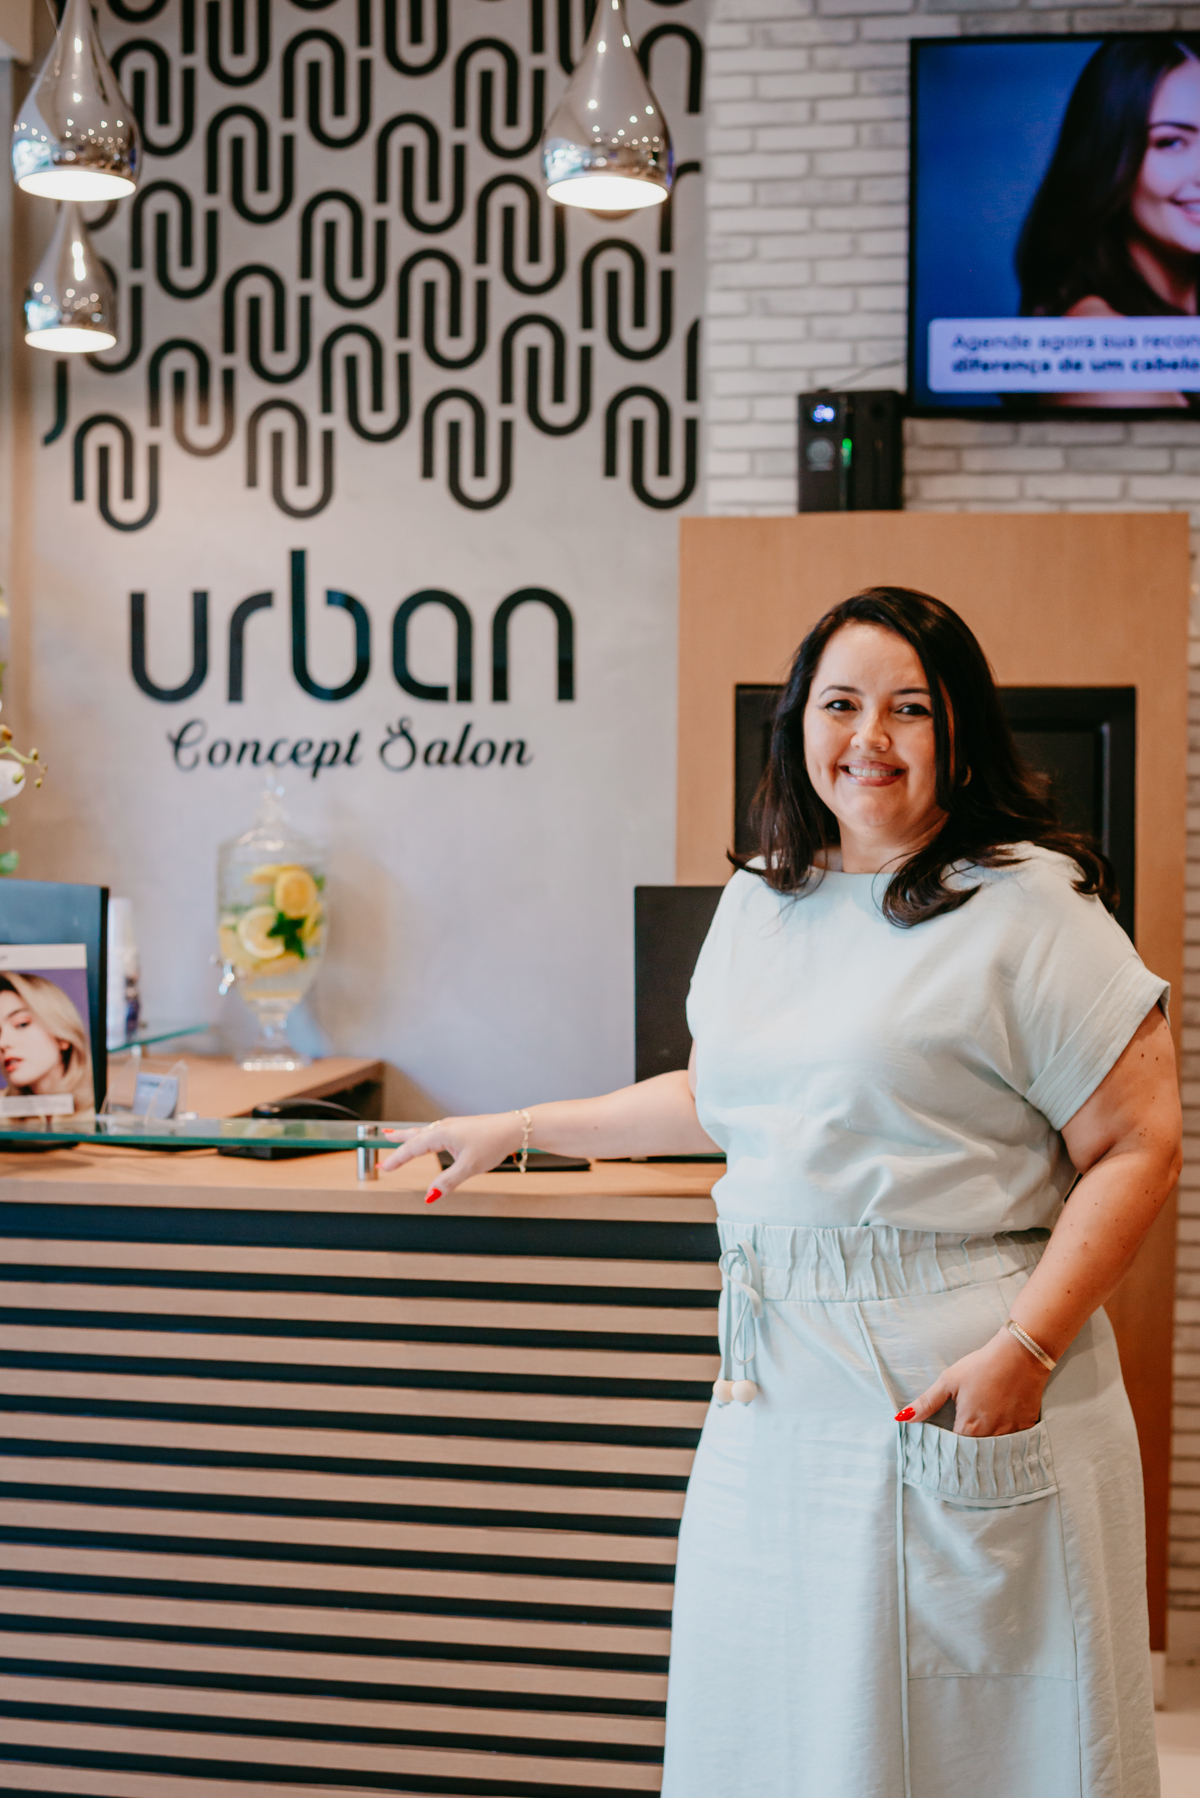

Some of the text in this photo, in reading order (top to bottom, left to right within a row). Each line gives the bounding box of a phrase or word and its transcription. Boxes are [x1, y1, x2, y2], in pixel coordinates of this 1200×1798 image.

[952, 334, 1031, 352] Agende
[1038, 336, 1096, 353] agora
[1102, 335, 1135, 350] sua
[952, 358, 1050, 377] diferença
[1058, 358, 1082, 374] de
[1090, 360, 1123, 374] um
[130, 549, 575, 703] urban
[168, 717, 534, 779] Concept Salon
